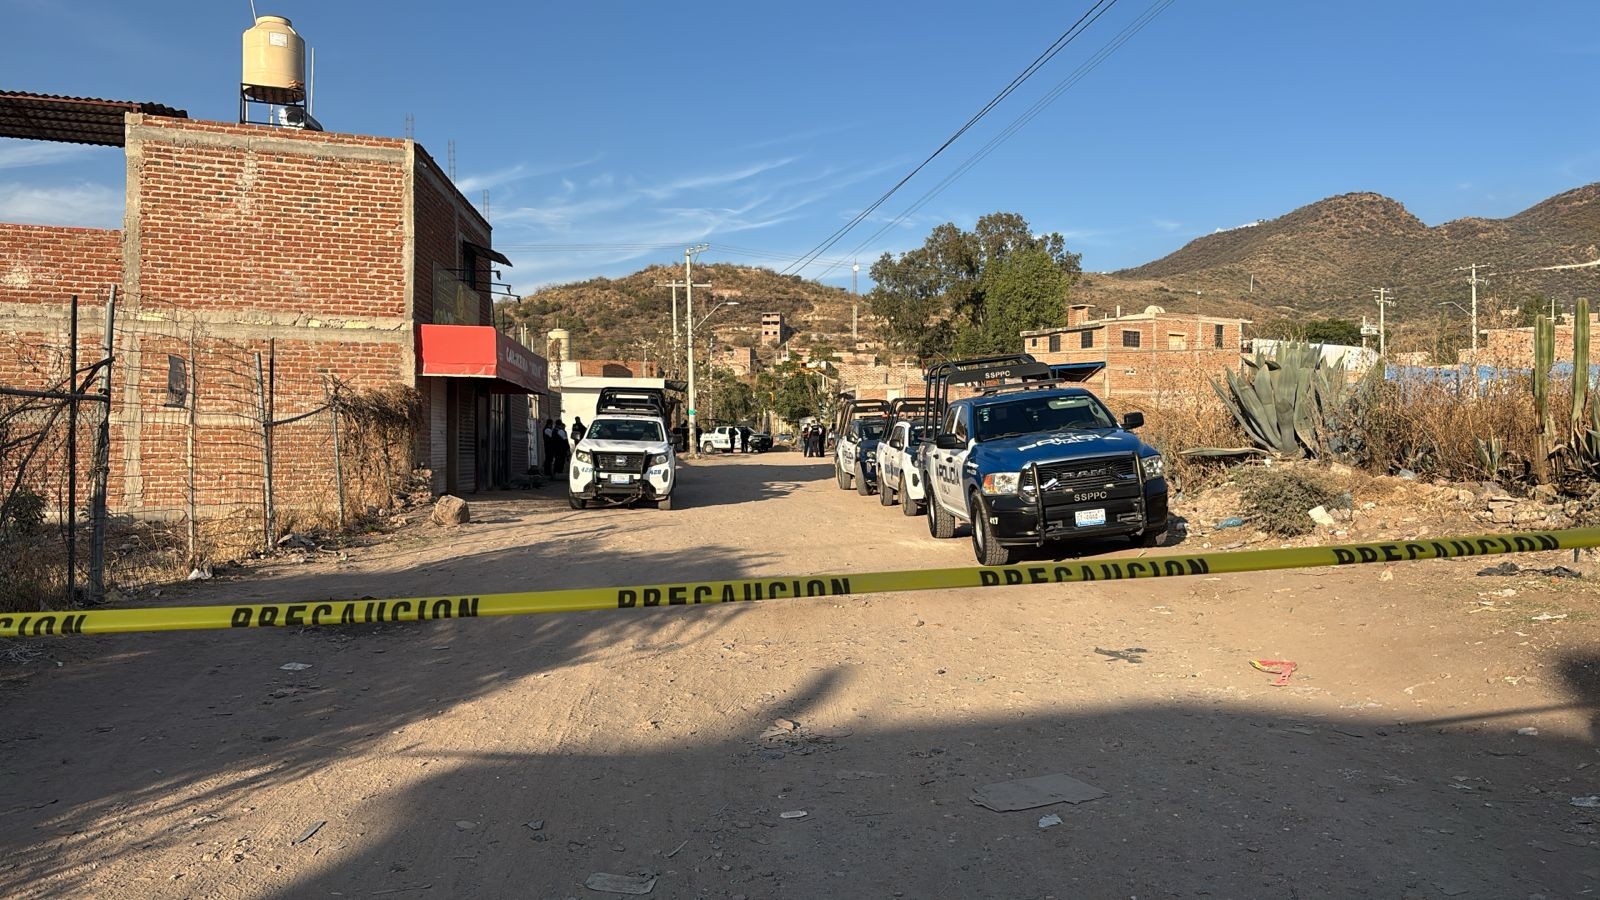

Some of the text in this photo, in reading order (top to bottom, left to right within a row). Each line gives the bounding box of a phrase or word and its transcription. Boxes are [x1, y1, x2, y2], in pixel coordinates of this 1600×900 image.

[985, 370, 1010, 379] SSPPC
[1074, 491, 1107, 502] SSPPC
[618, 578, 850, 608] PRECAUCION
[979, 558, 1209, 587] PRECAUCION
